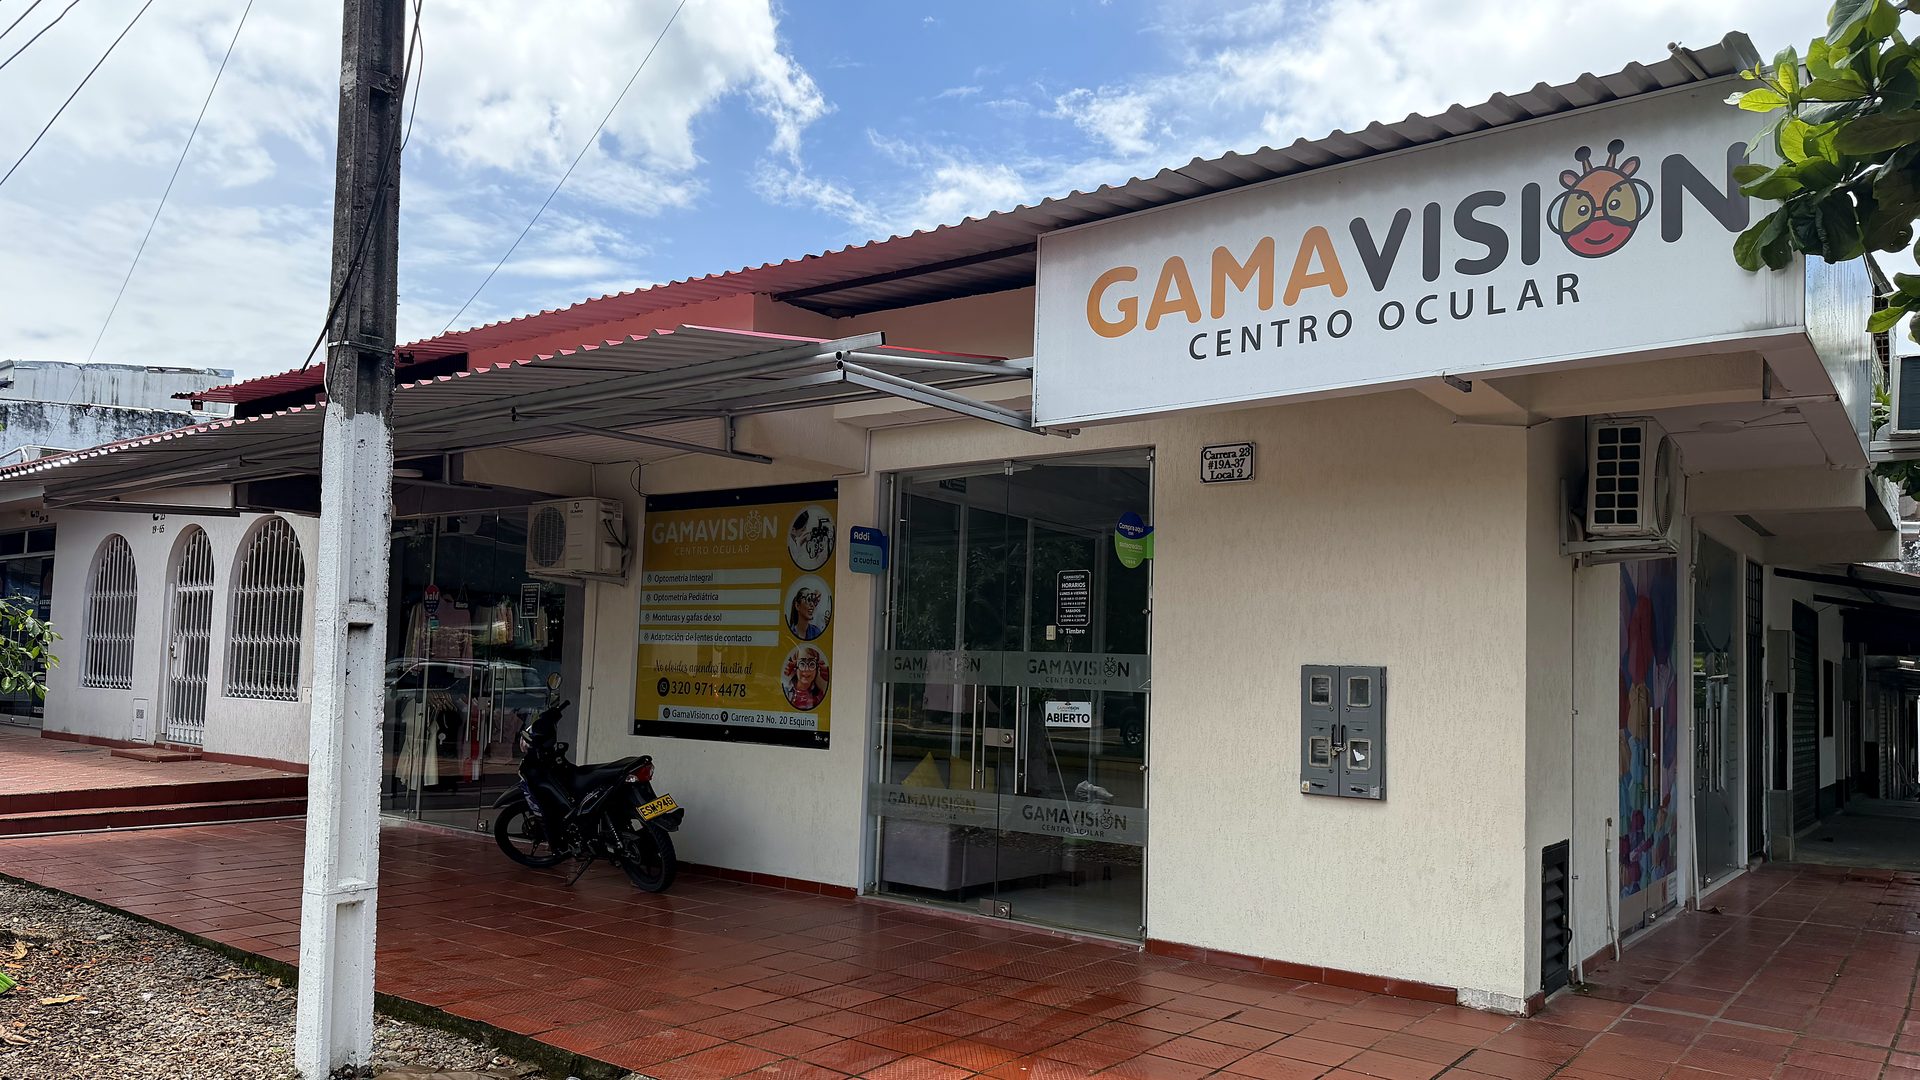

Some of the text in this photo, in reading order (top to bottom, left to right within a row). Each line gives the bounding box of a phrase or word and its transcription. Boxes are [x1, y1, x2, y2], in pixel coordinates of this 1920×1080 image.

[1189, 272, 1581, 361] CENTRO OCULAR
[1204, 447, 1251, 460] Carrera 23
[1208, 457, 1245, 470] #19A-37
[1210, 468, 1243, 480] Local 2
[652, 510, 778, 545] GAMAVISION
[854, 531, 870, 541] Addi
[674, 544, 751, 556] CENTRO OCULAR
[859, 557, 880, 566] cuotas
[689, 573, 714, 583] Integral
[688, 591, 719, 601] Pediátrica
[653, 613, 722, 623] Monturas y gafas de sol
[650, 633, 752, 643] Adaptación de lentes de contacto
[1027, 657, 1130, 677] GAMAVISION
[671, 681, 746, 697] 320 971 4478
[671, 709, 815, 727] GamaVision.co Carrera 23 No. 20 Esquina
[1047, 713, 1090, 723] ABIERTO
[1022, 804, 1127, 830] GAMAVISION
[1041, 824, 1071, 834] CENTRO
